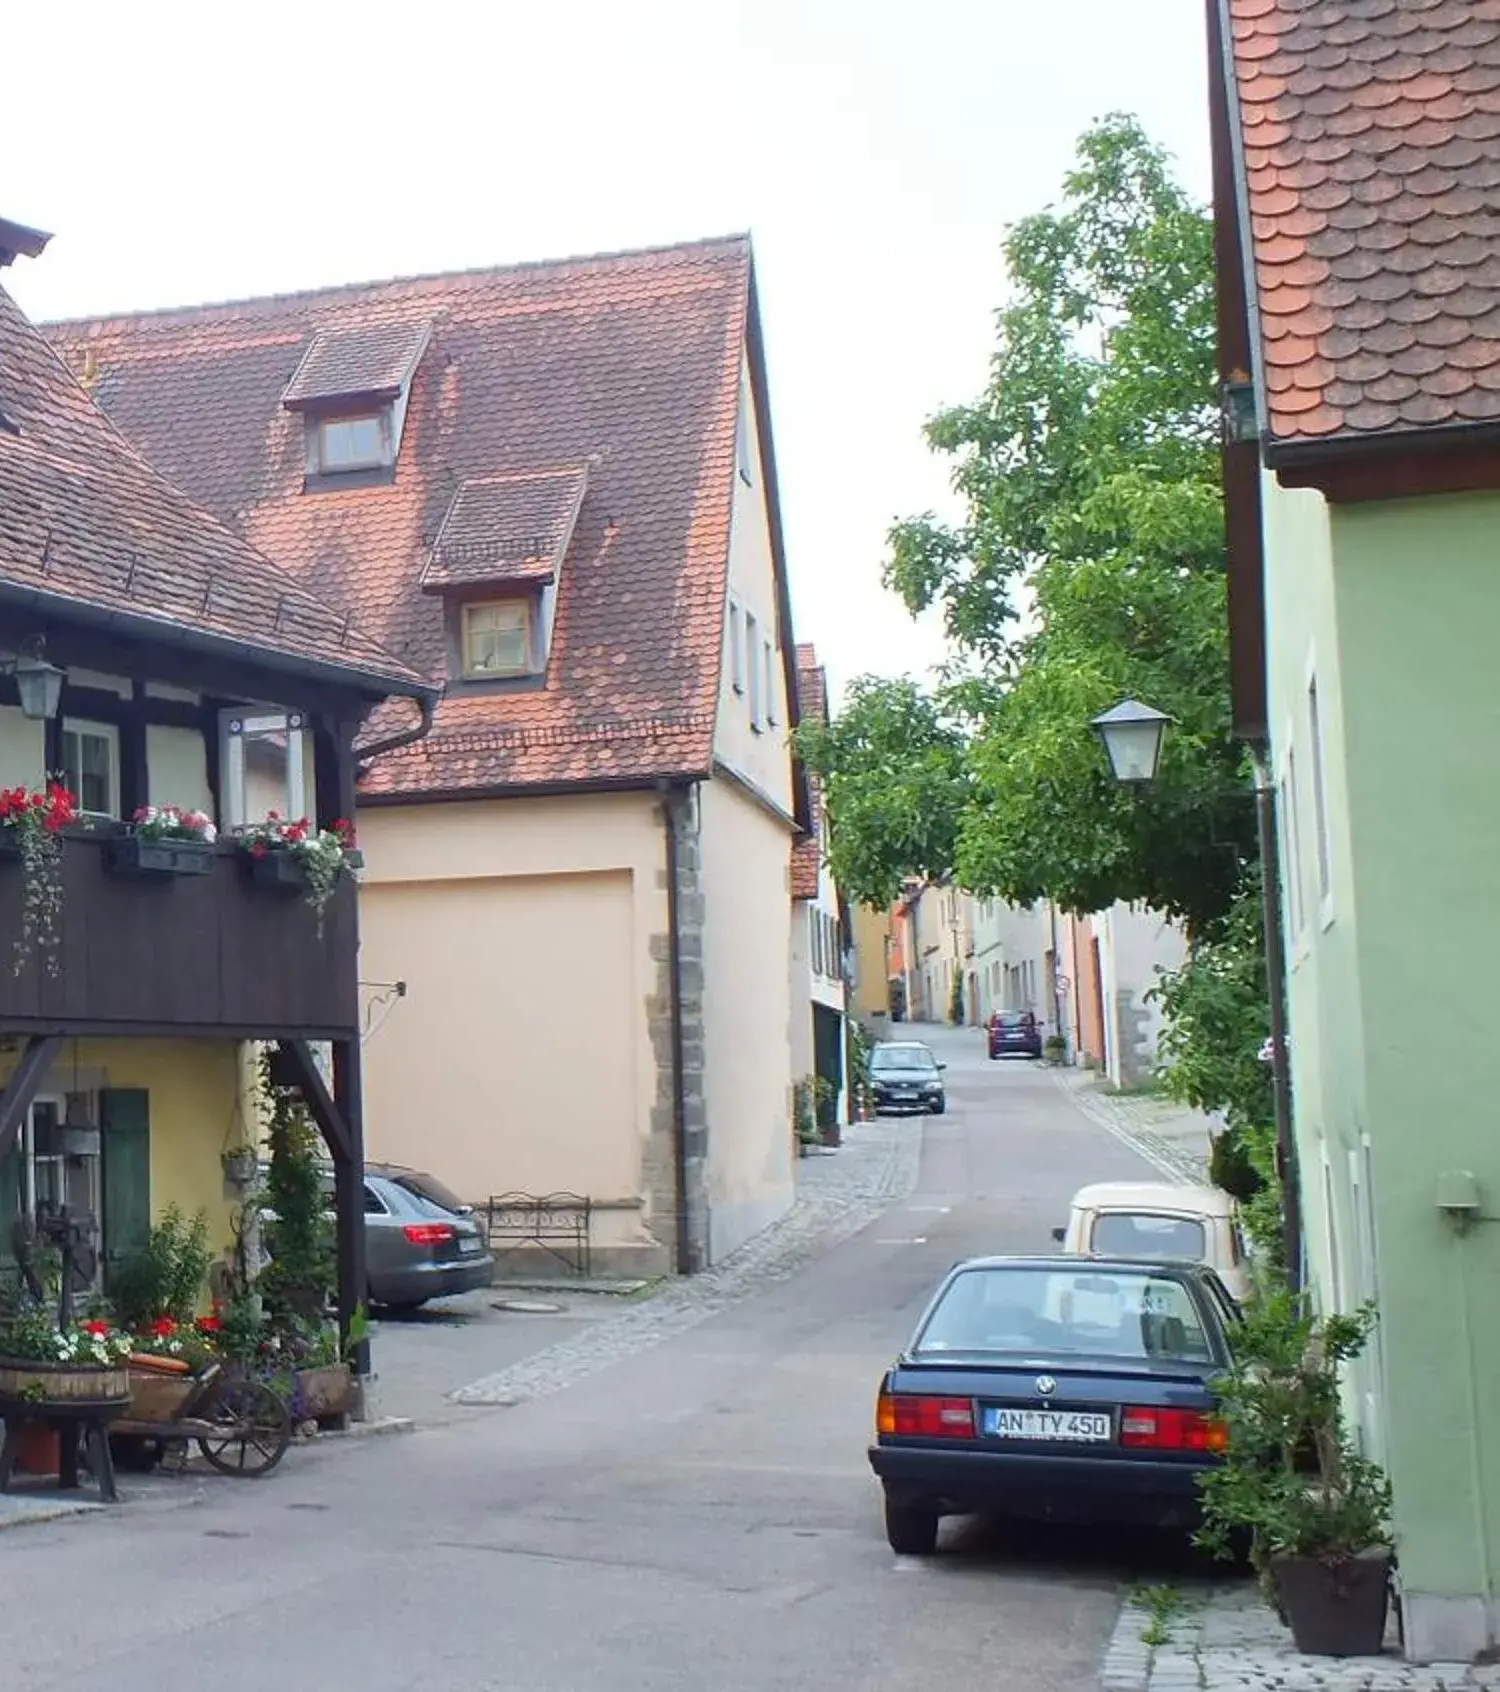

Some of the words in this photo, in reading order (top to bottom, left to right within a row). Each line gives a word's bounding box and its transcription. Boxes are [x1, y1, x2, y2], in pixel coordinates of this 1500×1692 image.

[998, 1411, 1023, 1431] AN
[1037, 1413, 1063, 1433] TY
[1067, 1415, 1106, 1436] 450
